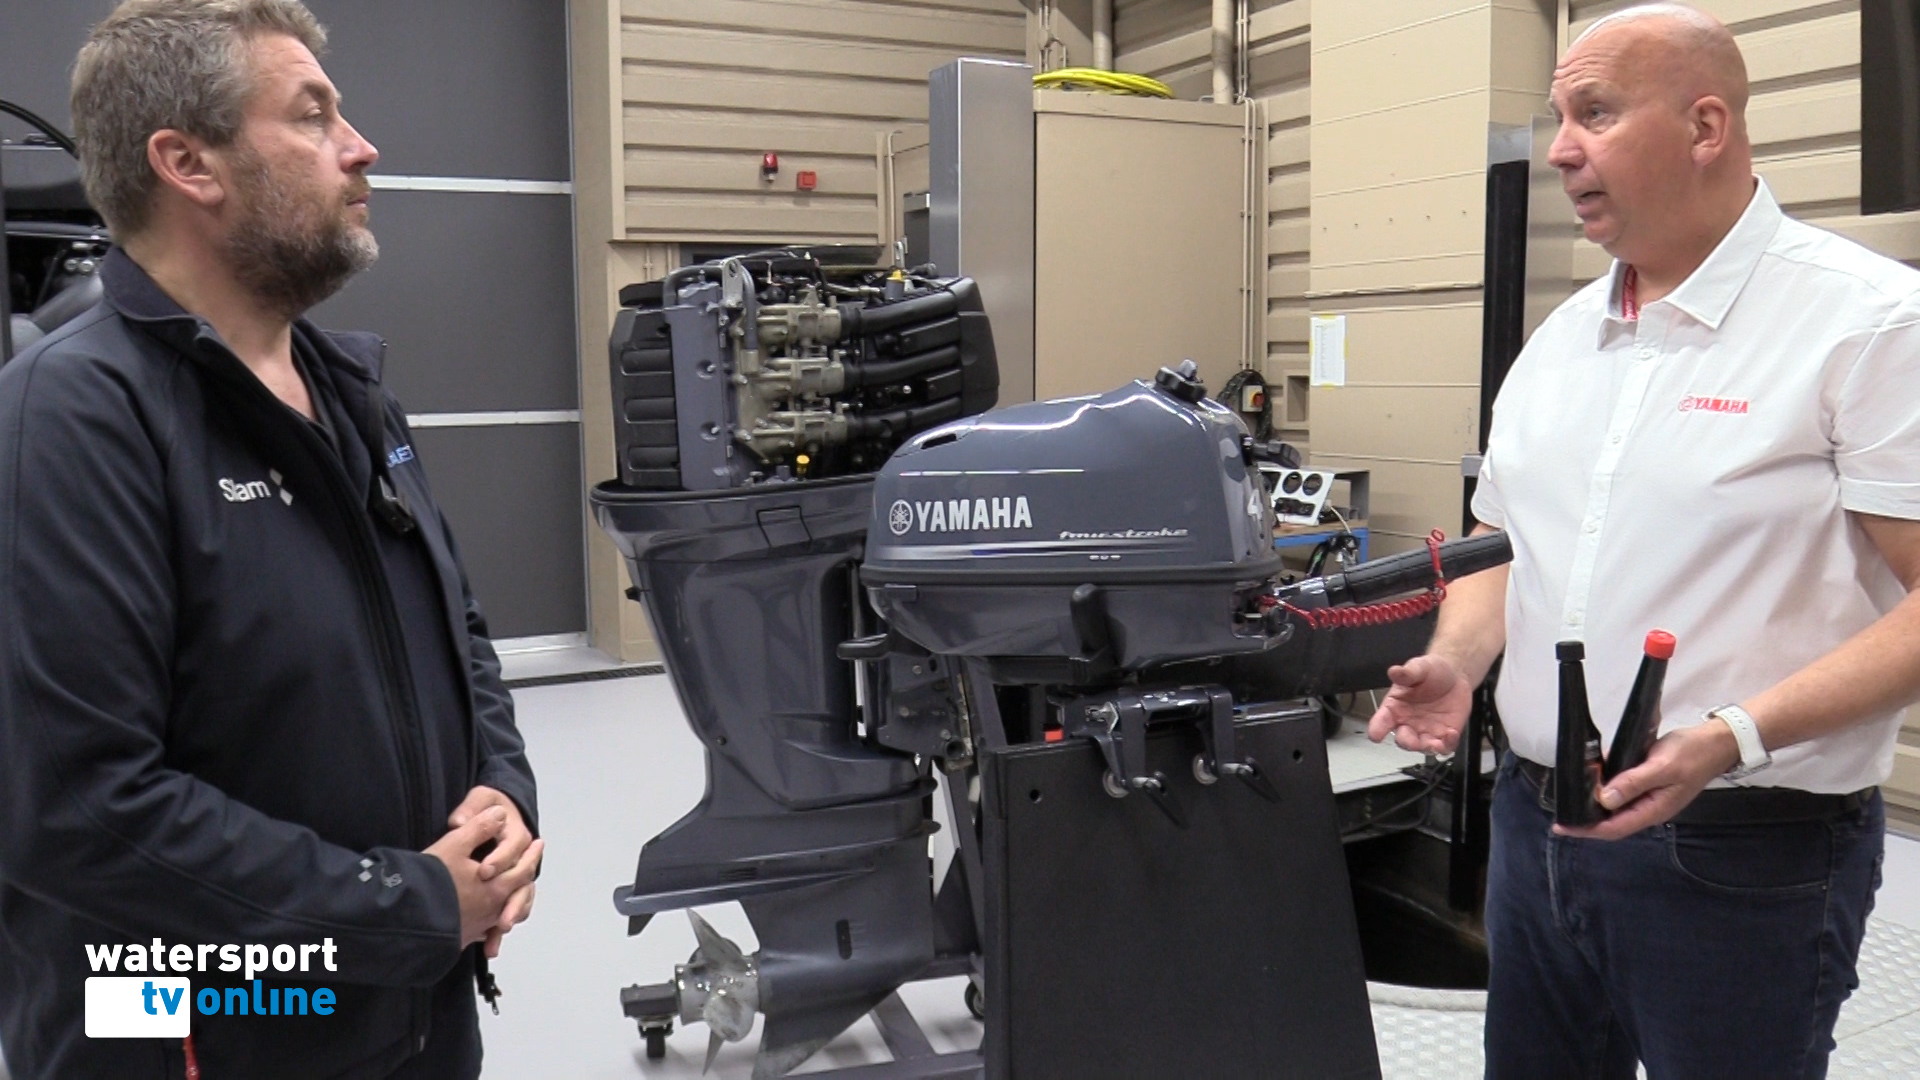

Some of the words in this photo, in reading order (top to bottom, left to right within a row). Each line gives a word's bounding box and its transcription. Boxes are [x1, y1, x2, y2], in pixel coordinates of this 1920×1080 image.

[1694, 397, 1748, 413] YAMAHA
[219, 477, 272, 502] Slam
[915, 496, 1033, 532] YAMAHA
